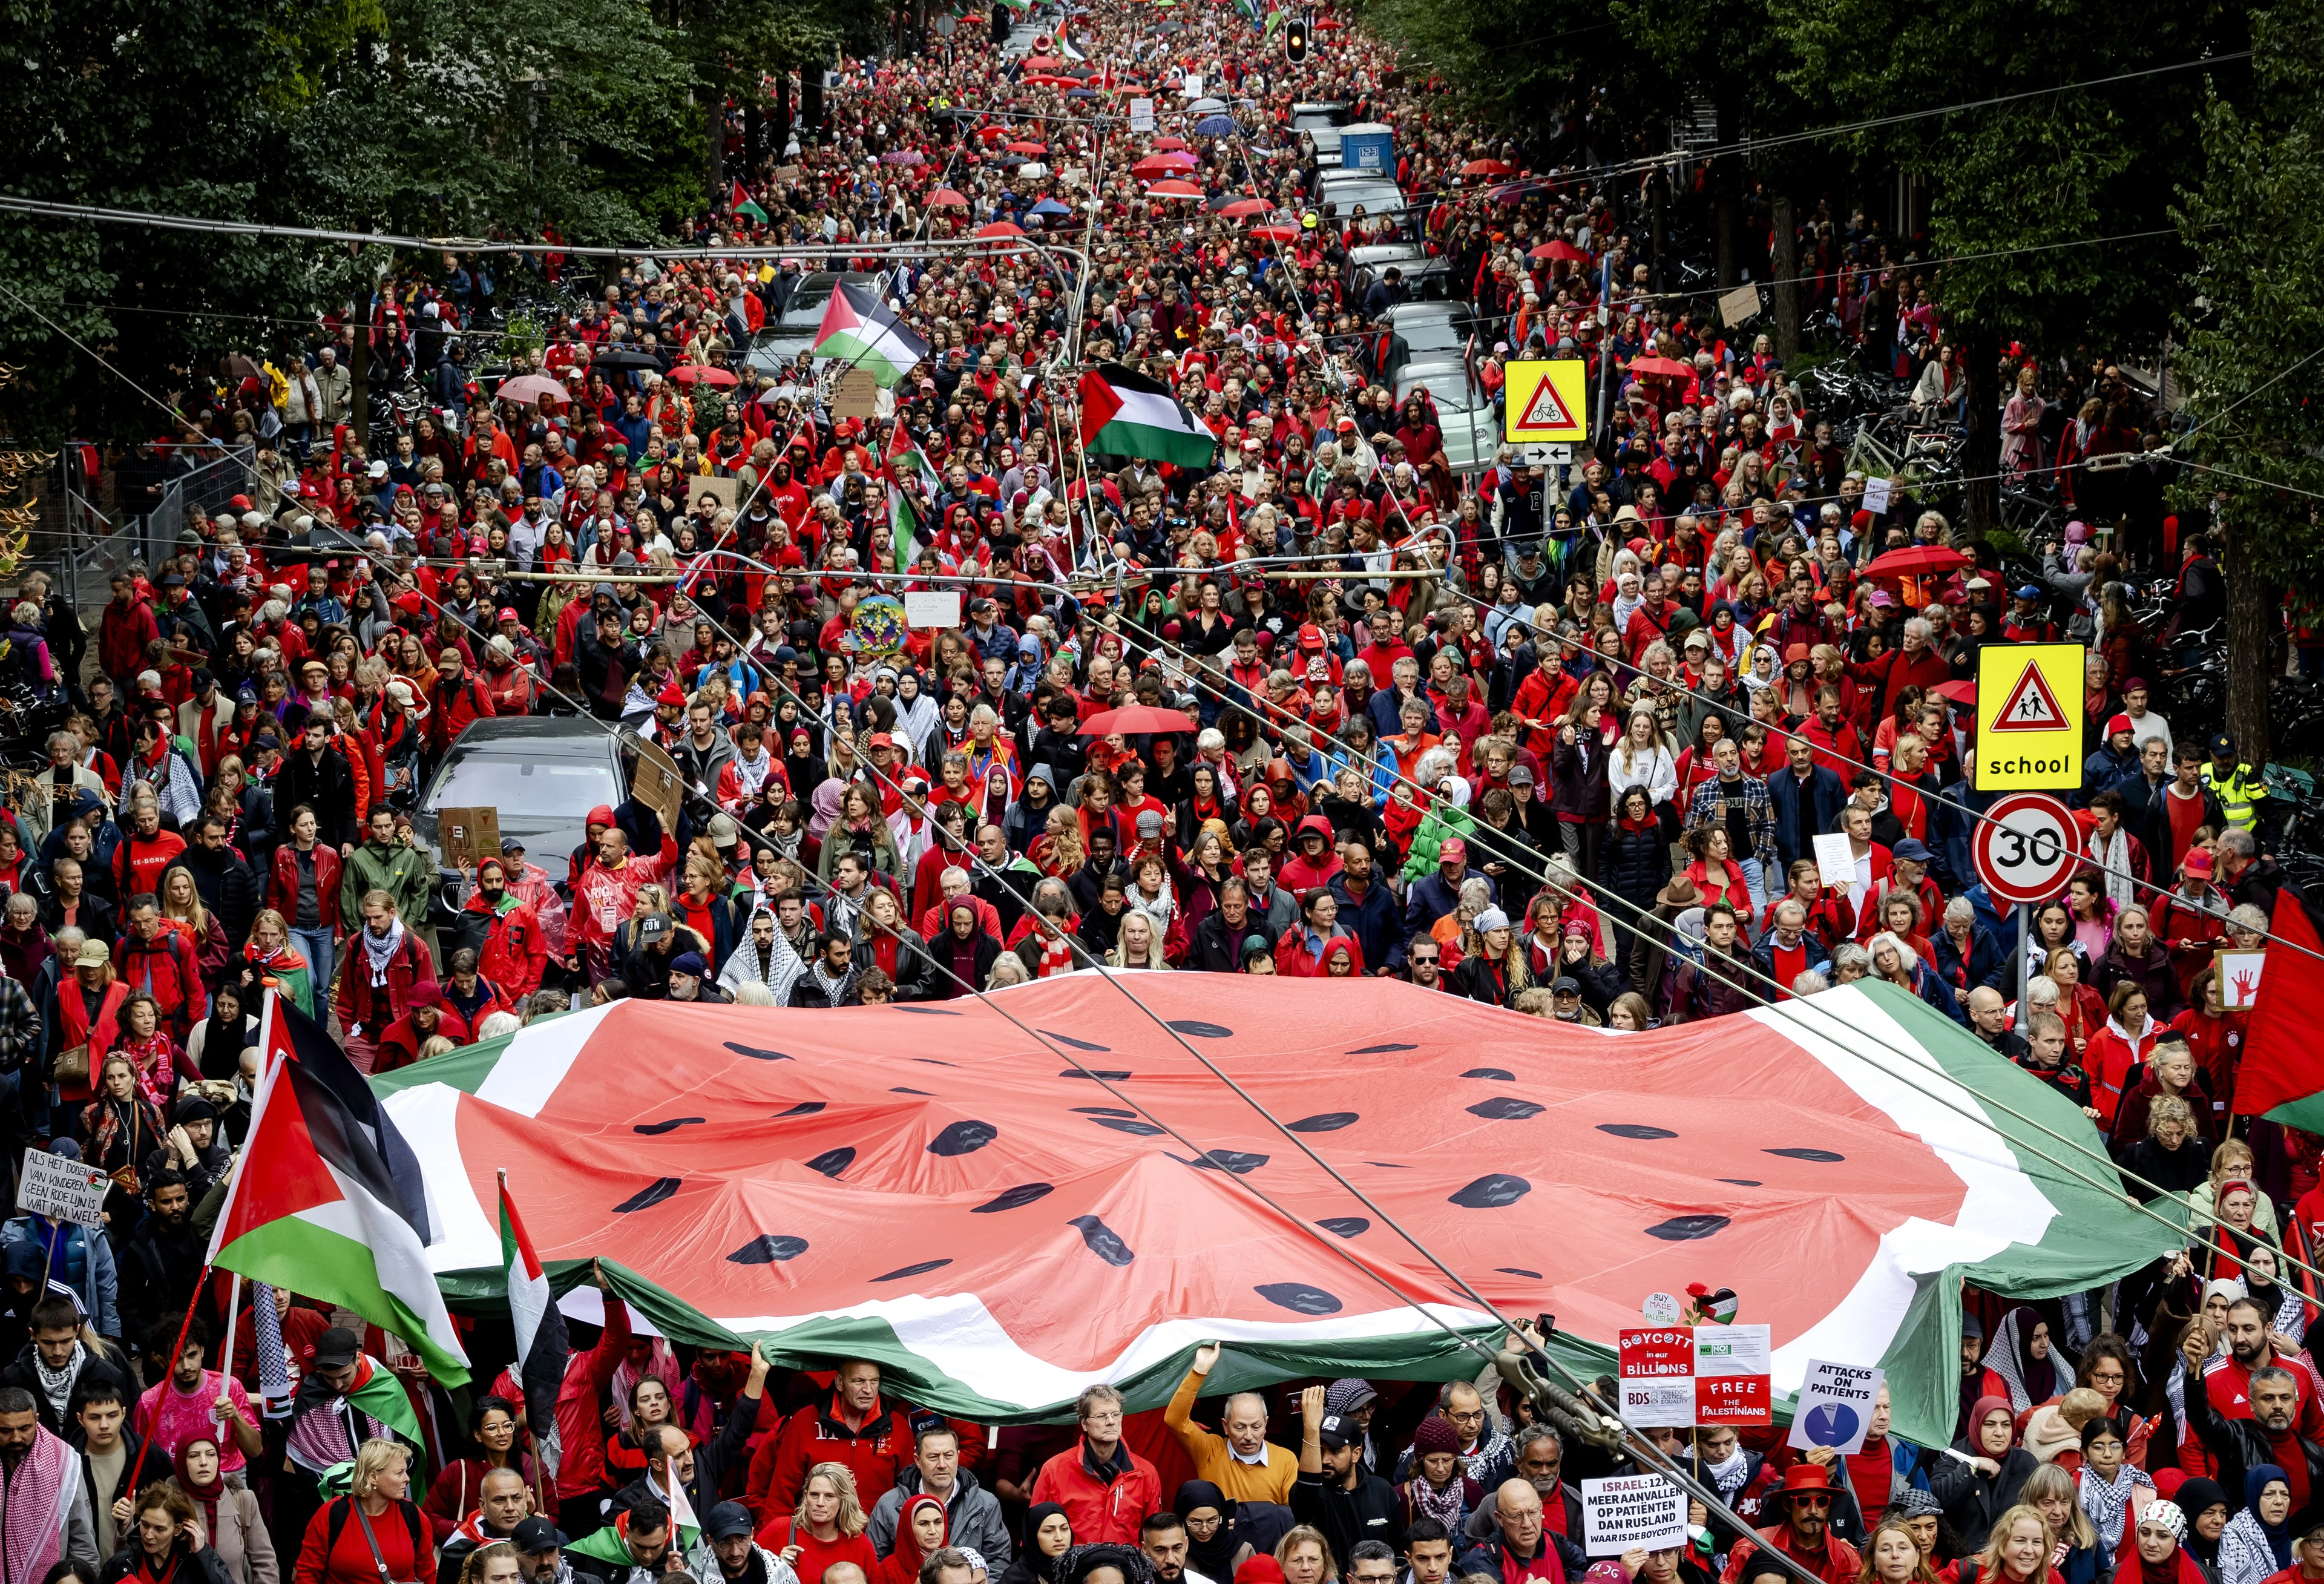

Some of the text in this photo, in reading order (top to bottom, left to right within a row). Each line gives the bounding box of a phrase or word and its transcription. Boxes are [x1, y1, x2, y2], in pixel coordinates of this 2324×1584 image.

[1530, 491, 1541, 510] B
[1990, 755, 2069, 774] school
[1997, 827, 2061, 867] 30
[133, 856, 165, 866] RE-BORN
[642, 921, 659, 931] ICON
[28, 1151, 91, 1178] ALS HET DODEN
[30, 1168, 47, 1182] VAN
[25, 1182, 48, 1198] GEEN
[50, 1190, 68, 1203] RODE
[26, 1195, 100, 1224] WAT DAN WEL?
[1650, 1301, 1672, 1310] MADE
[1654, 1294, 1669, 1303] BUY
[1716, 1301, 1736, 1313] FREE
[1621, 1333, 1693, 1349] BOYCOTT
[1818, 1364, 1873, 1380] ATTACKS
[1710, 1382, 1756, 1395] FREE
[1834, 1377, 1853, 1388] ON
[1628, 1392, 1650, 1405] BDS
[1811, 1383, 1871, 1399] PATIENTS
[1587, 1487, 1682, 1506] MEER AANVALLEN
[1597, 1500, 1676, 1518] OP PATIËNTEN
[1598, 1512, 1676, 1530] DAN RUSLAND
[1590, 1534, 1618, 1543] WAAR
[1641, 1525, 1683, 1539] BOYCOTT?!
